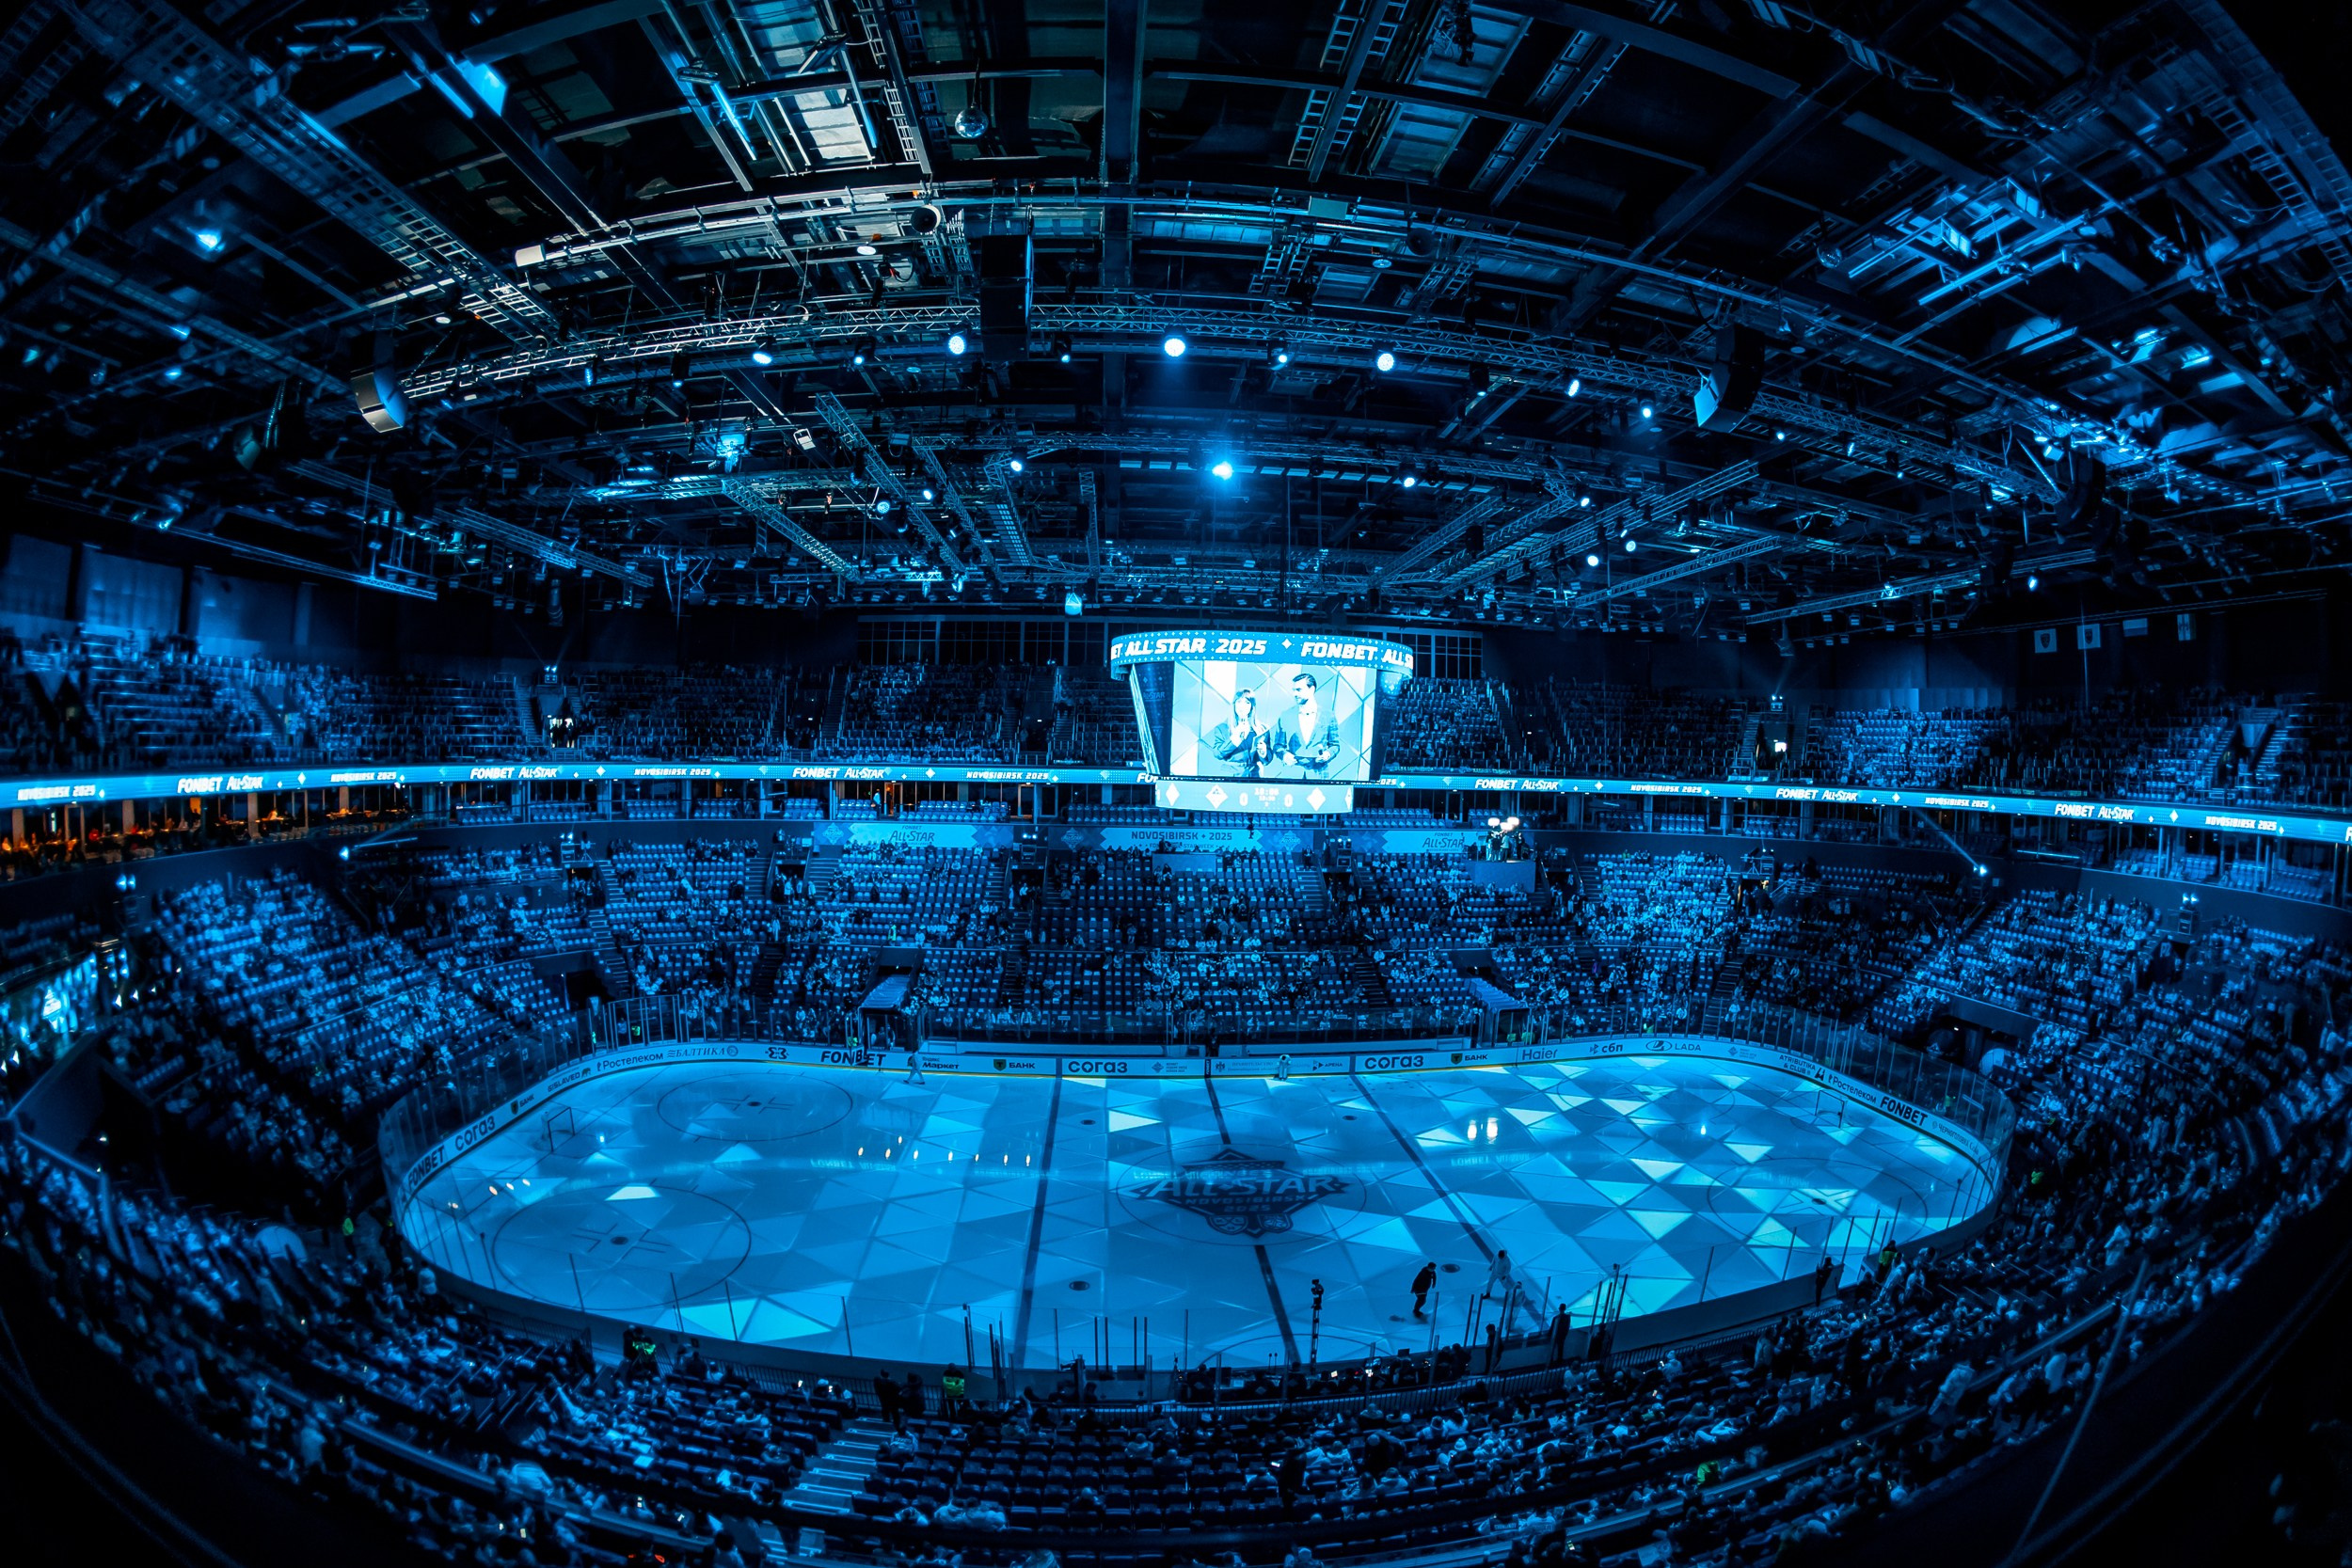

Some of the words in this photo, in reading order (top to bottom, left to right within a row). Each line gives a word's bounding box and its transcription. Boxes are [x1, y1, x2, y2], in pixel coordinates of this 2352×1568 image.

[1154, 638, 1206, 654] STAR
[1216, 639, 1267, 655] 2025
[1300, 641, 1378, 661] FONBET
[470, 767, 515, 780] FONBET
[634, 768, 687, 776] NOVOSIBIRSK
[690, 768, 711, 776] 2025
[793, 767, 840, 779] FONBET
[966, 771, 1023, 780] NOVOSIBIRSK
[1025, 771, 1049, 780] 2025
[177, 777, 223, 794] FONBET
[1475, 779, 1518, 790] FONBET
[1681, 785, 1702, 794] 2025
[1776, 788, 1818, 800] FONBET
[2055, 803, 2095, 818] FONBET
[1131, 831, 1199, 840] NOVOSIBIRSK
[1209, 832, 1232, 841] 2025
[675, 1047, 725, 1058] БАЛТИКА
[1601, 1042, 1624, 1053] сбп
[1675, 1043, 1701, 1052] LADA
[820, 1051, 886, 1067] FONBET
[1522, 1048, 1558, 1060] Haier
[603, 1053, 663, 1070] Ростелеком
[1779, 1054, 1816, 1070] ATRIBUTIKA
[1789, 1064, 1806, 1074] CLUB
[548, 1071, 580, 1092] GISLAVED
[1833, 1077, 1877, 1104] Ростелеком
[519, 1094, 535, 1108] БАНК
[1880, 1096, 1929, 1127] FONBET
[407, 1145, 445, 1192] FONBET
[1185, 1195, 1309, 1205] NOVOSIBIRSK
[1225, 1204, 1270, 1213] 2025
